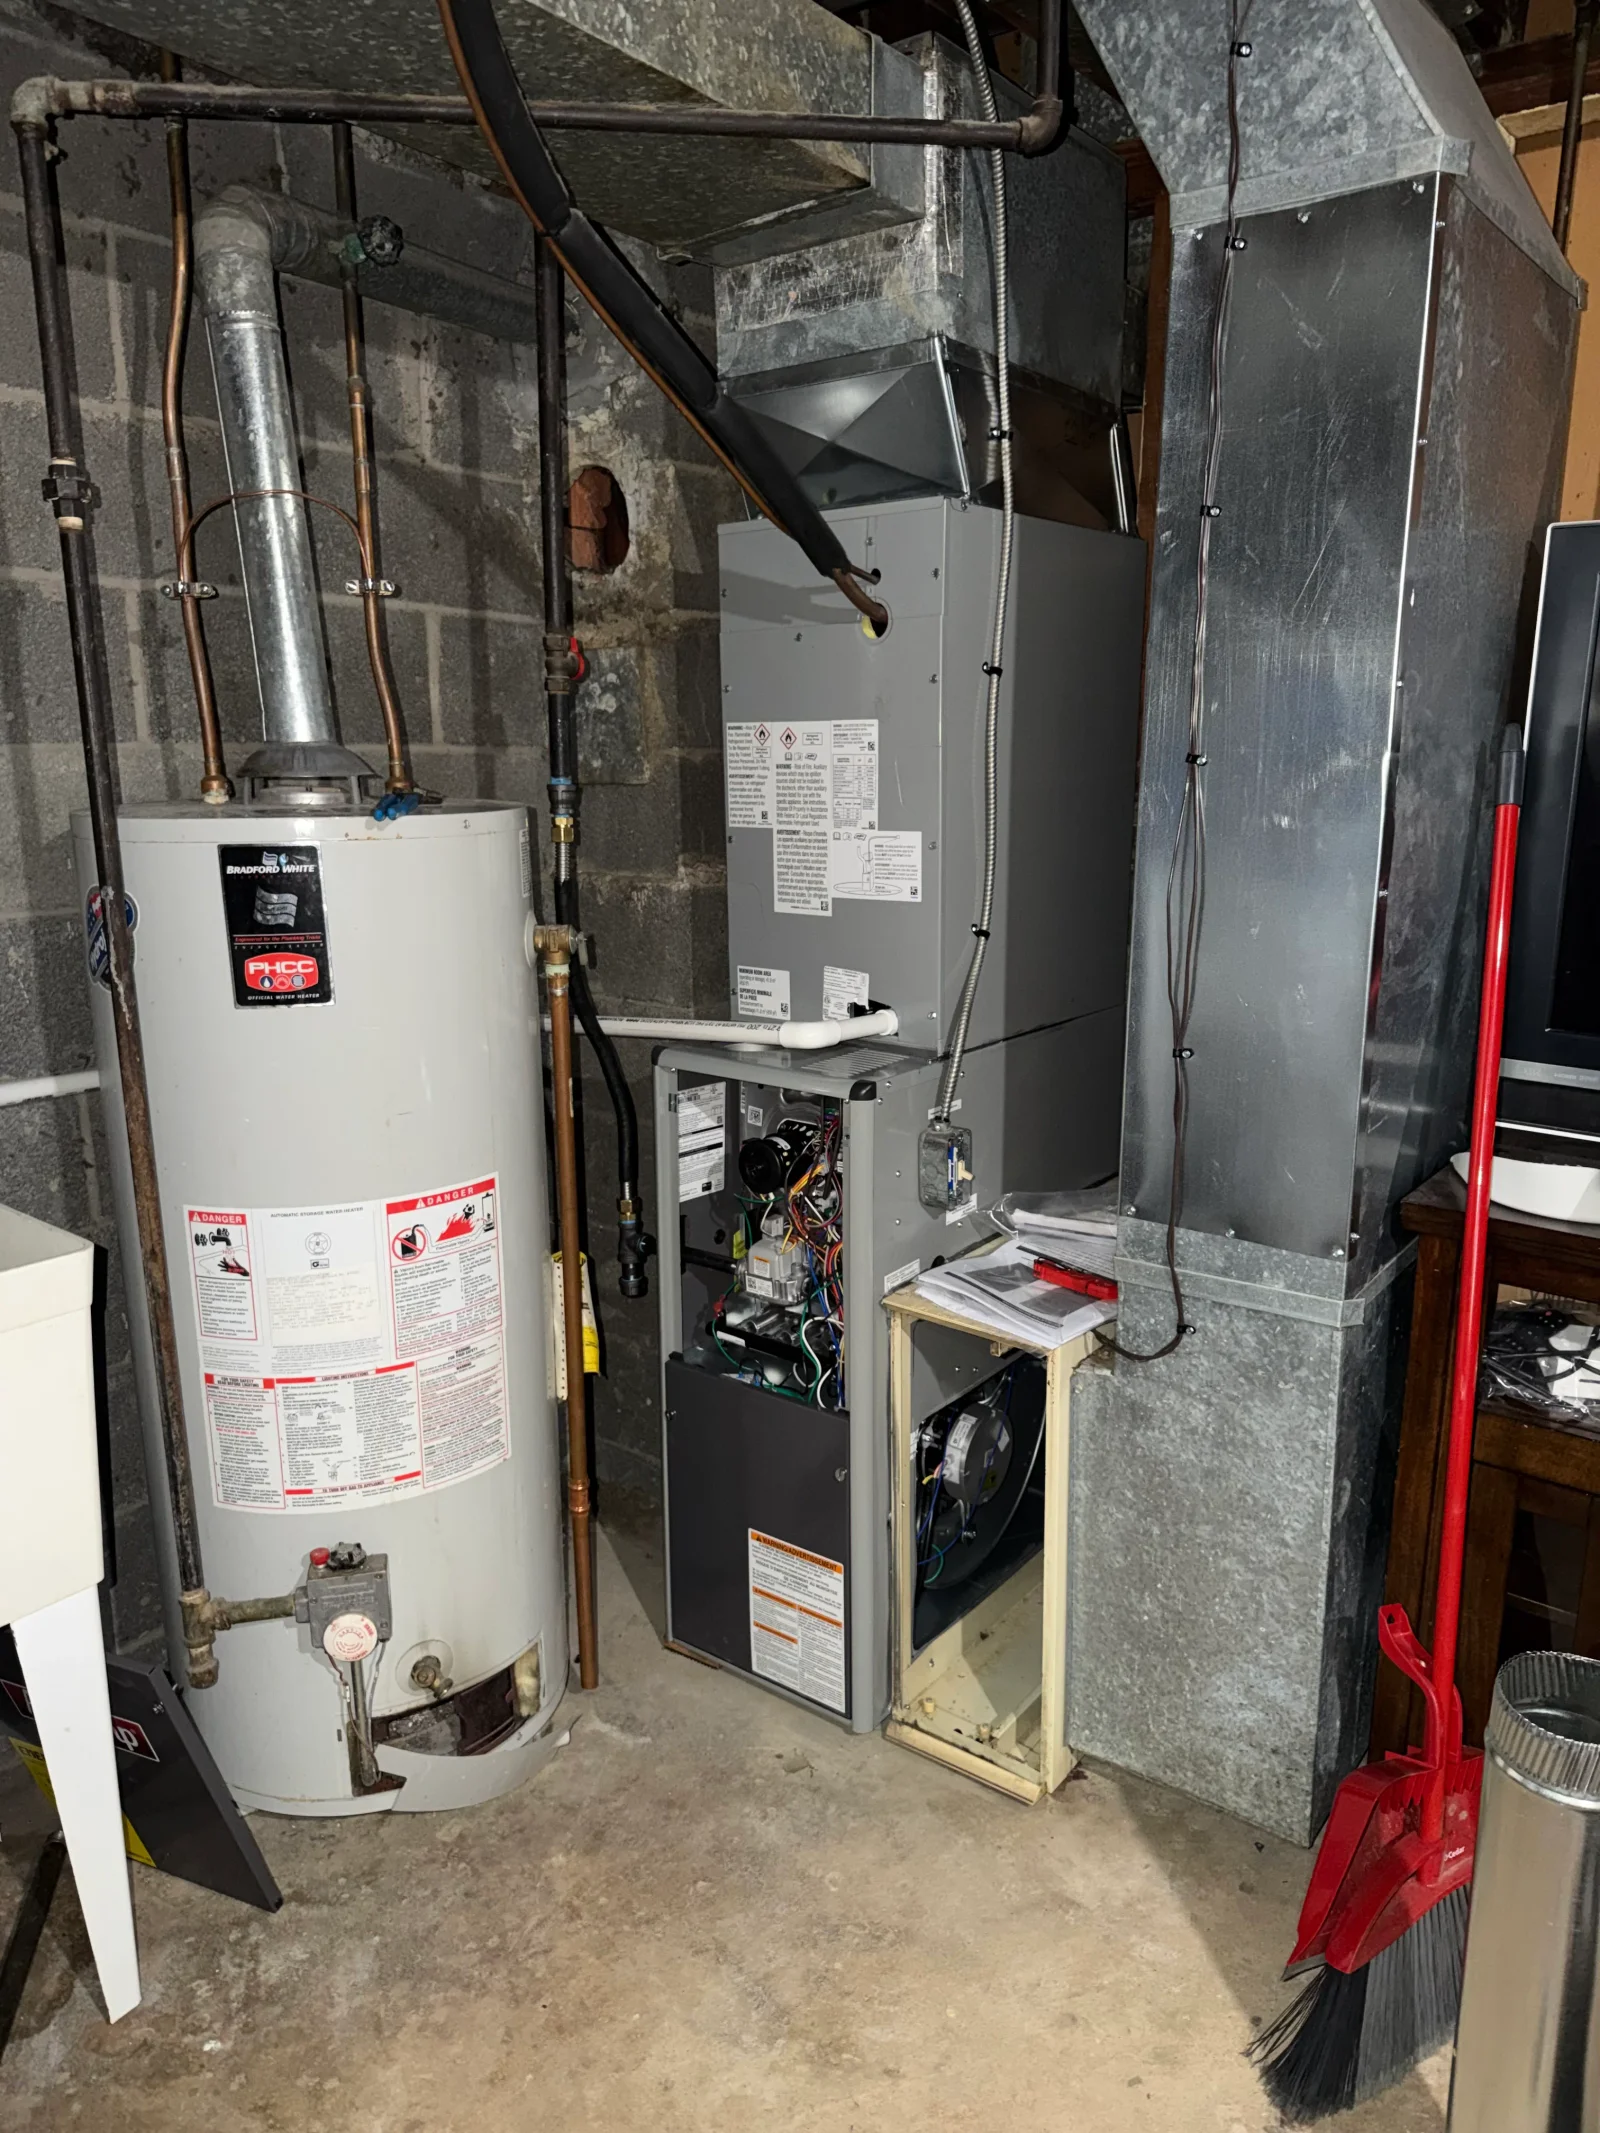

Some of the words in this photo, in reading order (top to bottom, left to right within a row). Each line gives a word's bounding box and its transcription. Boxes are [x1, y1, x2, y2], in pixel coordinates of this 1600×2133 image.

[226, 865, 280, 875] BRADFORD
[282, 864, 315, 874] WHITE
[248, 959, 314, 975] PHCC
[427, 1187, 474, 1206] DANGER
[201, 1213, 243, 1224] DANGER
